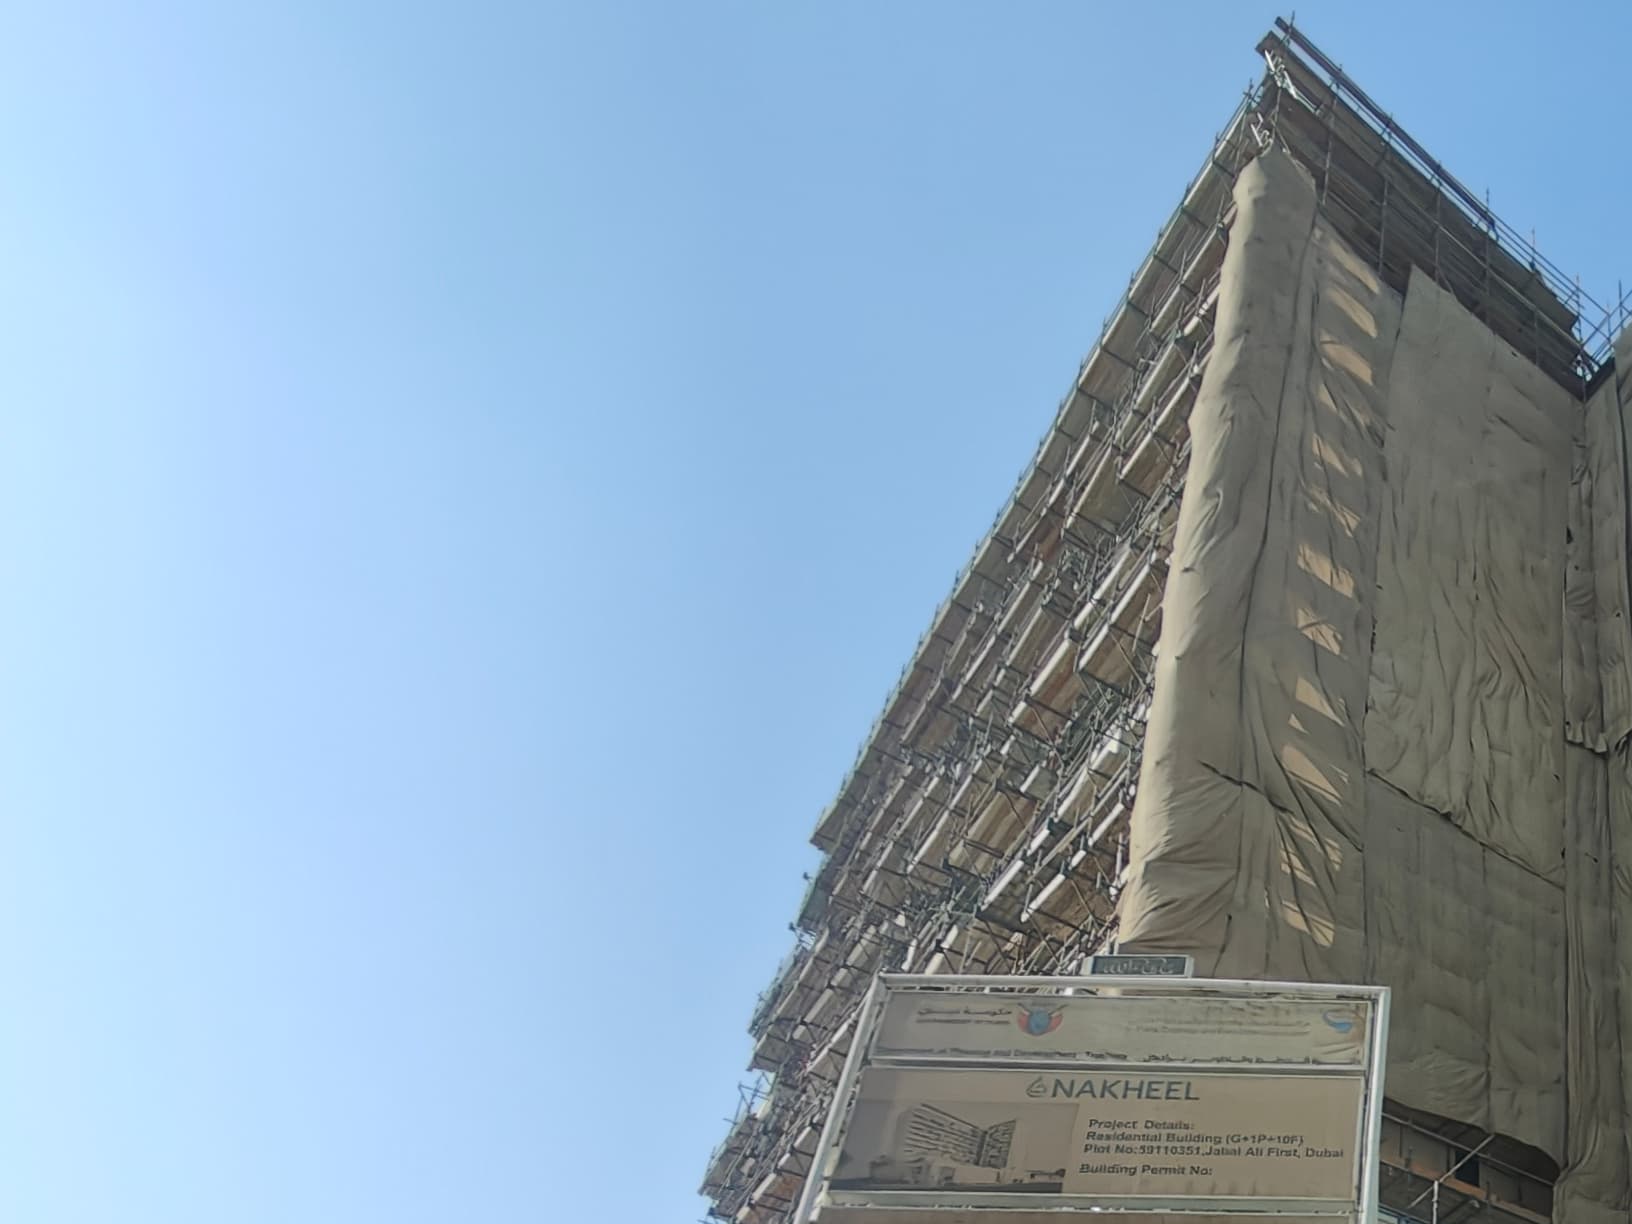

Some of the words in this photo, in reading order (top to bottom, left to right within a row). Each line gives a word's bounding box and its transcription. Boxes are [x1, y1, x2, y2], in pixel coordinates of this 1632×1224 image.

[1051, 1078, 1201, 1101] NAKHEEL
[1088, 1118, 1138, 1130] Project
[1086, 1131, 1162, 1142] Residential
[1166, 1132, 1223, 1145] Building
[1084, 1143, 1111, 1154] Plot
[1245, 1147, 1263, 1157] Ali
[1305, 1147, 1344, 1158] Dubai
[1079, 1163, 1138, 1177] Building
[1141, 1164, 1186, 1175] Permit
[1189, 1166, 1214, 1176] No:
